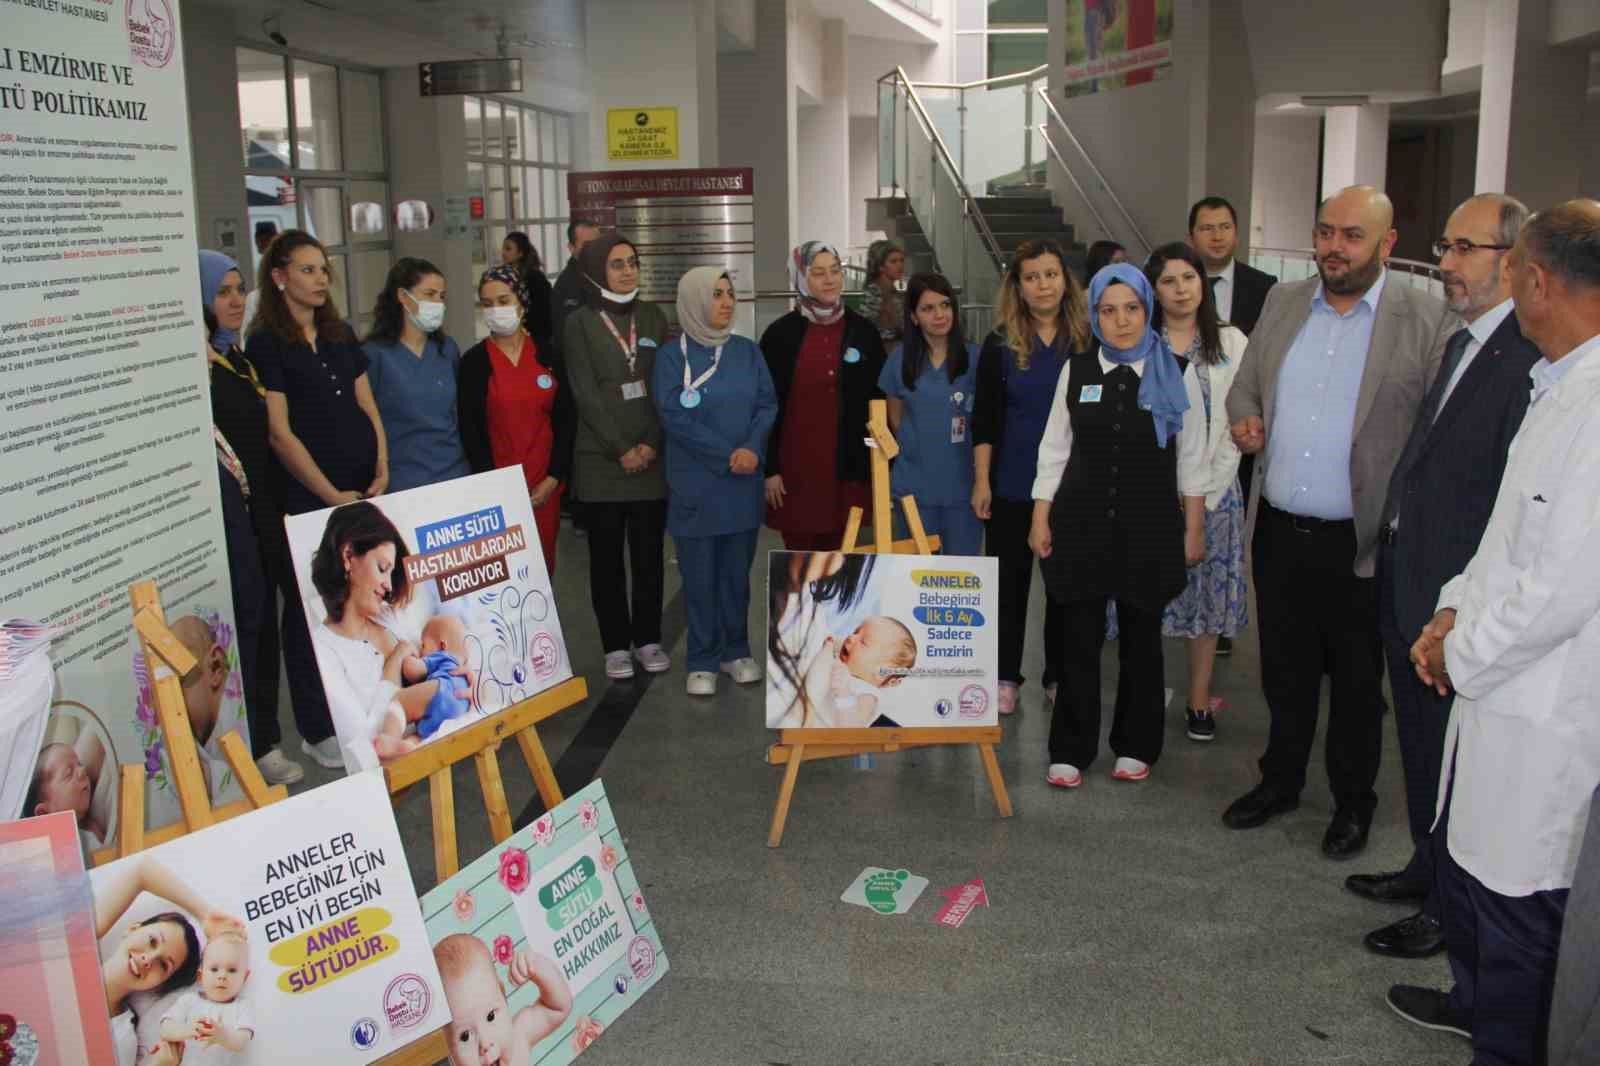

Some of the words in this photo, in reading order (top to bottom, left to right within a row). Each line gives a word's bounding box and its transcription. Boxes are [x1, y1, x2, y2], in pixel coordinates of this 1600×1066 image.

[24, 0, 60, 12] DEVLET
[61, 5, 109, 22] HASTANESİ
[17, 49, 108, 82] EMZİRME
[111, 64, 134, 86] VE
[32, 89, 148, 121] POLİTİKAMIZ
[693, 174, 744, 190] HASTANESİ
[426, 522, 464, 549] ANNE
[466, 511, 500, 539] SÜTÜ
[408, 531, 524, 580] HASTALIKLARDAN
[442, 561, 504, 596] KORUYOR
[920, 575, 982, 589] ANNELER
[927, 628, 972, 640] Sadece
[944, 610, 954, 623] 6
[957, 610, 973, 626] Ay
[926, 644, 974, 657] Emzirin
[265, 832, 356, 884] ANNELER
[244, 864, 347, 921] BEBEĞİNİZ
[348, 848, 386, 879] İÇİN
[552, 864, 586, 904] ANNE
[264, 916, 294, 943] EN
[296, 898, 324, 930] İYİ
[326, 878, 382, 918] BESİN
[306, 916, 361, 956] ANNE
[554, 932, 574, 959] EN
[562, 921, 622, 980] HAKKIMIZ
[288, 936, 389, 992] SÜTÜDÜR.
